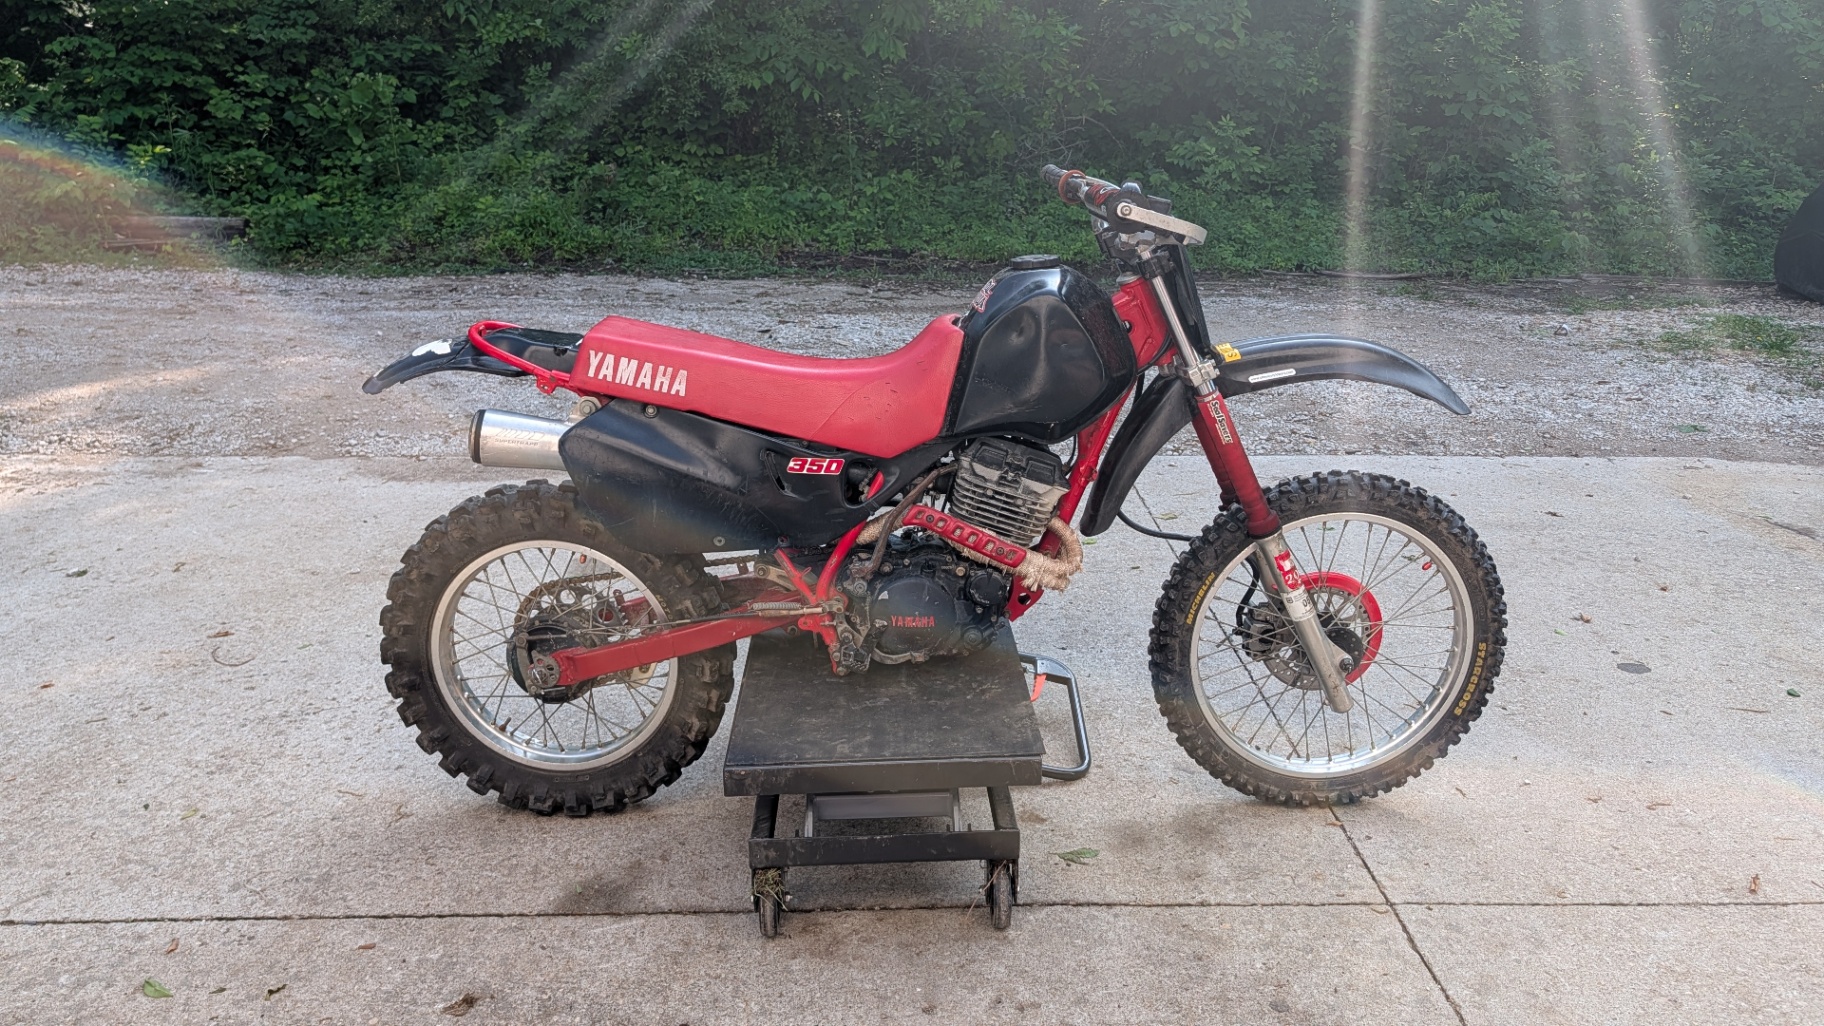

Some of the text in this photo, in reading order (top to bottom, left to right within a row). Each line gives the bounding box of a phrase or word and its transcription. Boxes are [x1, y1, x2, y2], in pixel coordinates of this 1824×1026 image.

[587, 349, 688, 397] YAMAHA
[787, 457, 845, 475] 350
[891, 615, 935, 628] YAMAHA
[1186, 571, 1215, 625] MICHELIN
[1454, 642, 1487, 716] STARCROSS
